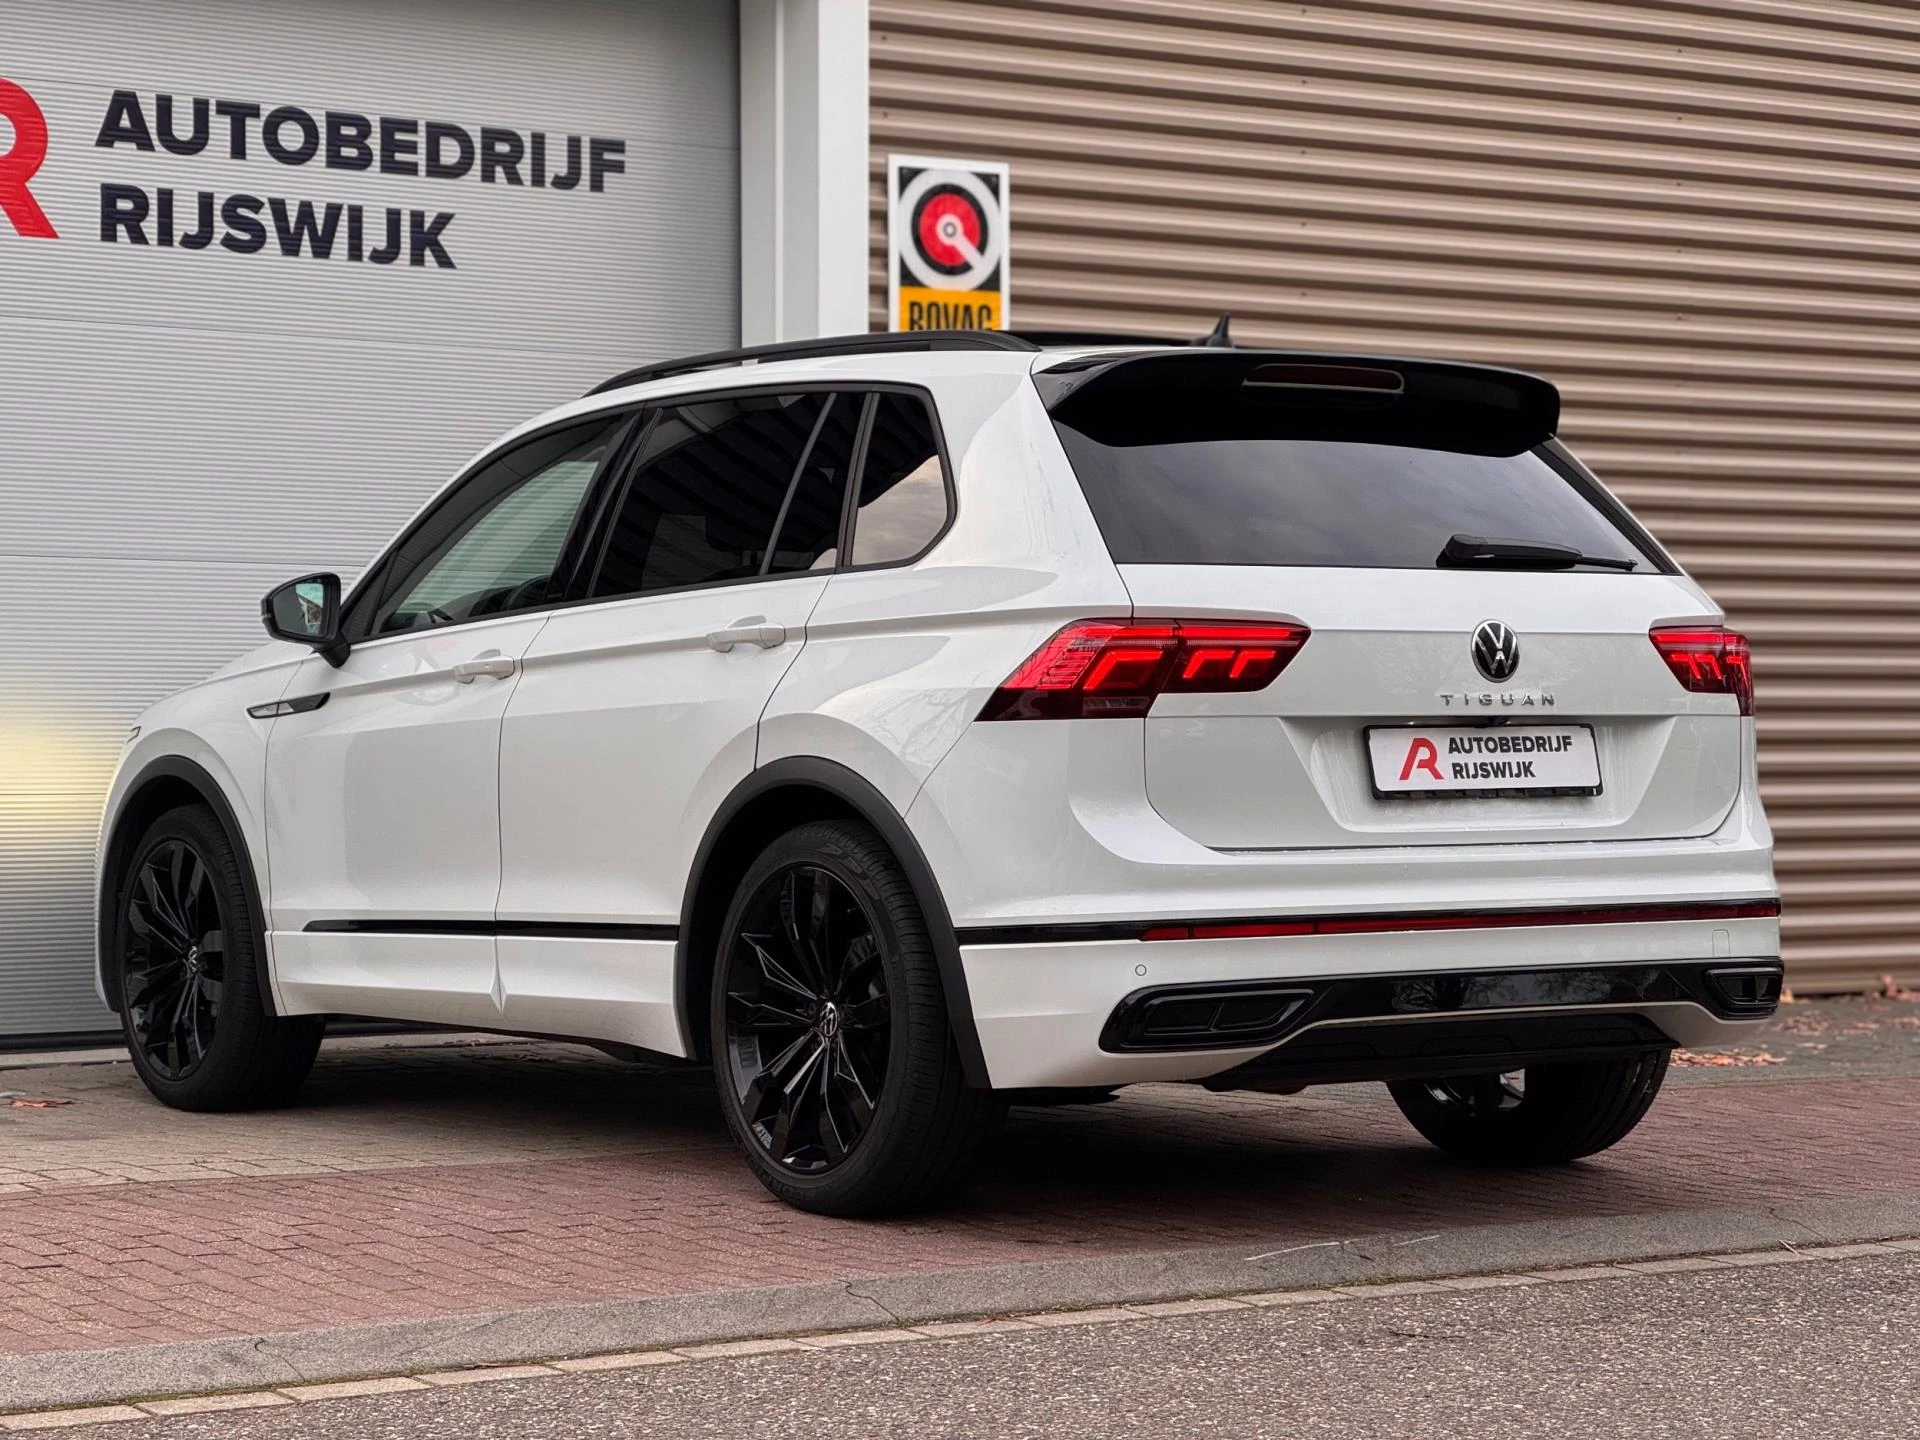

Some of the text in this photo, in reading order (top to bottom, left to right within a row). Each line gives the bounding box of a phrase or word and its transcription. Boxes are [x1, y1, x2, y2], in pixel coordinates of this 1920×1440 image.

[95, 89, 626, 193] AUTOBEDRIJF
[100, 183, 457, 270] RIJSWIJK
[1440, 693, 1555, 706] TIGUAN
[1448, 735, 1573, 754] AUTOBEDRIJF
[1451, 761, 1537, 779] RIJSWIJK
